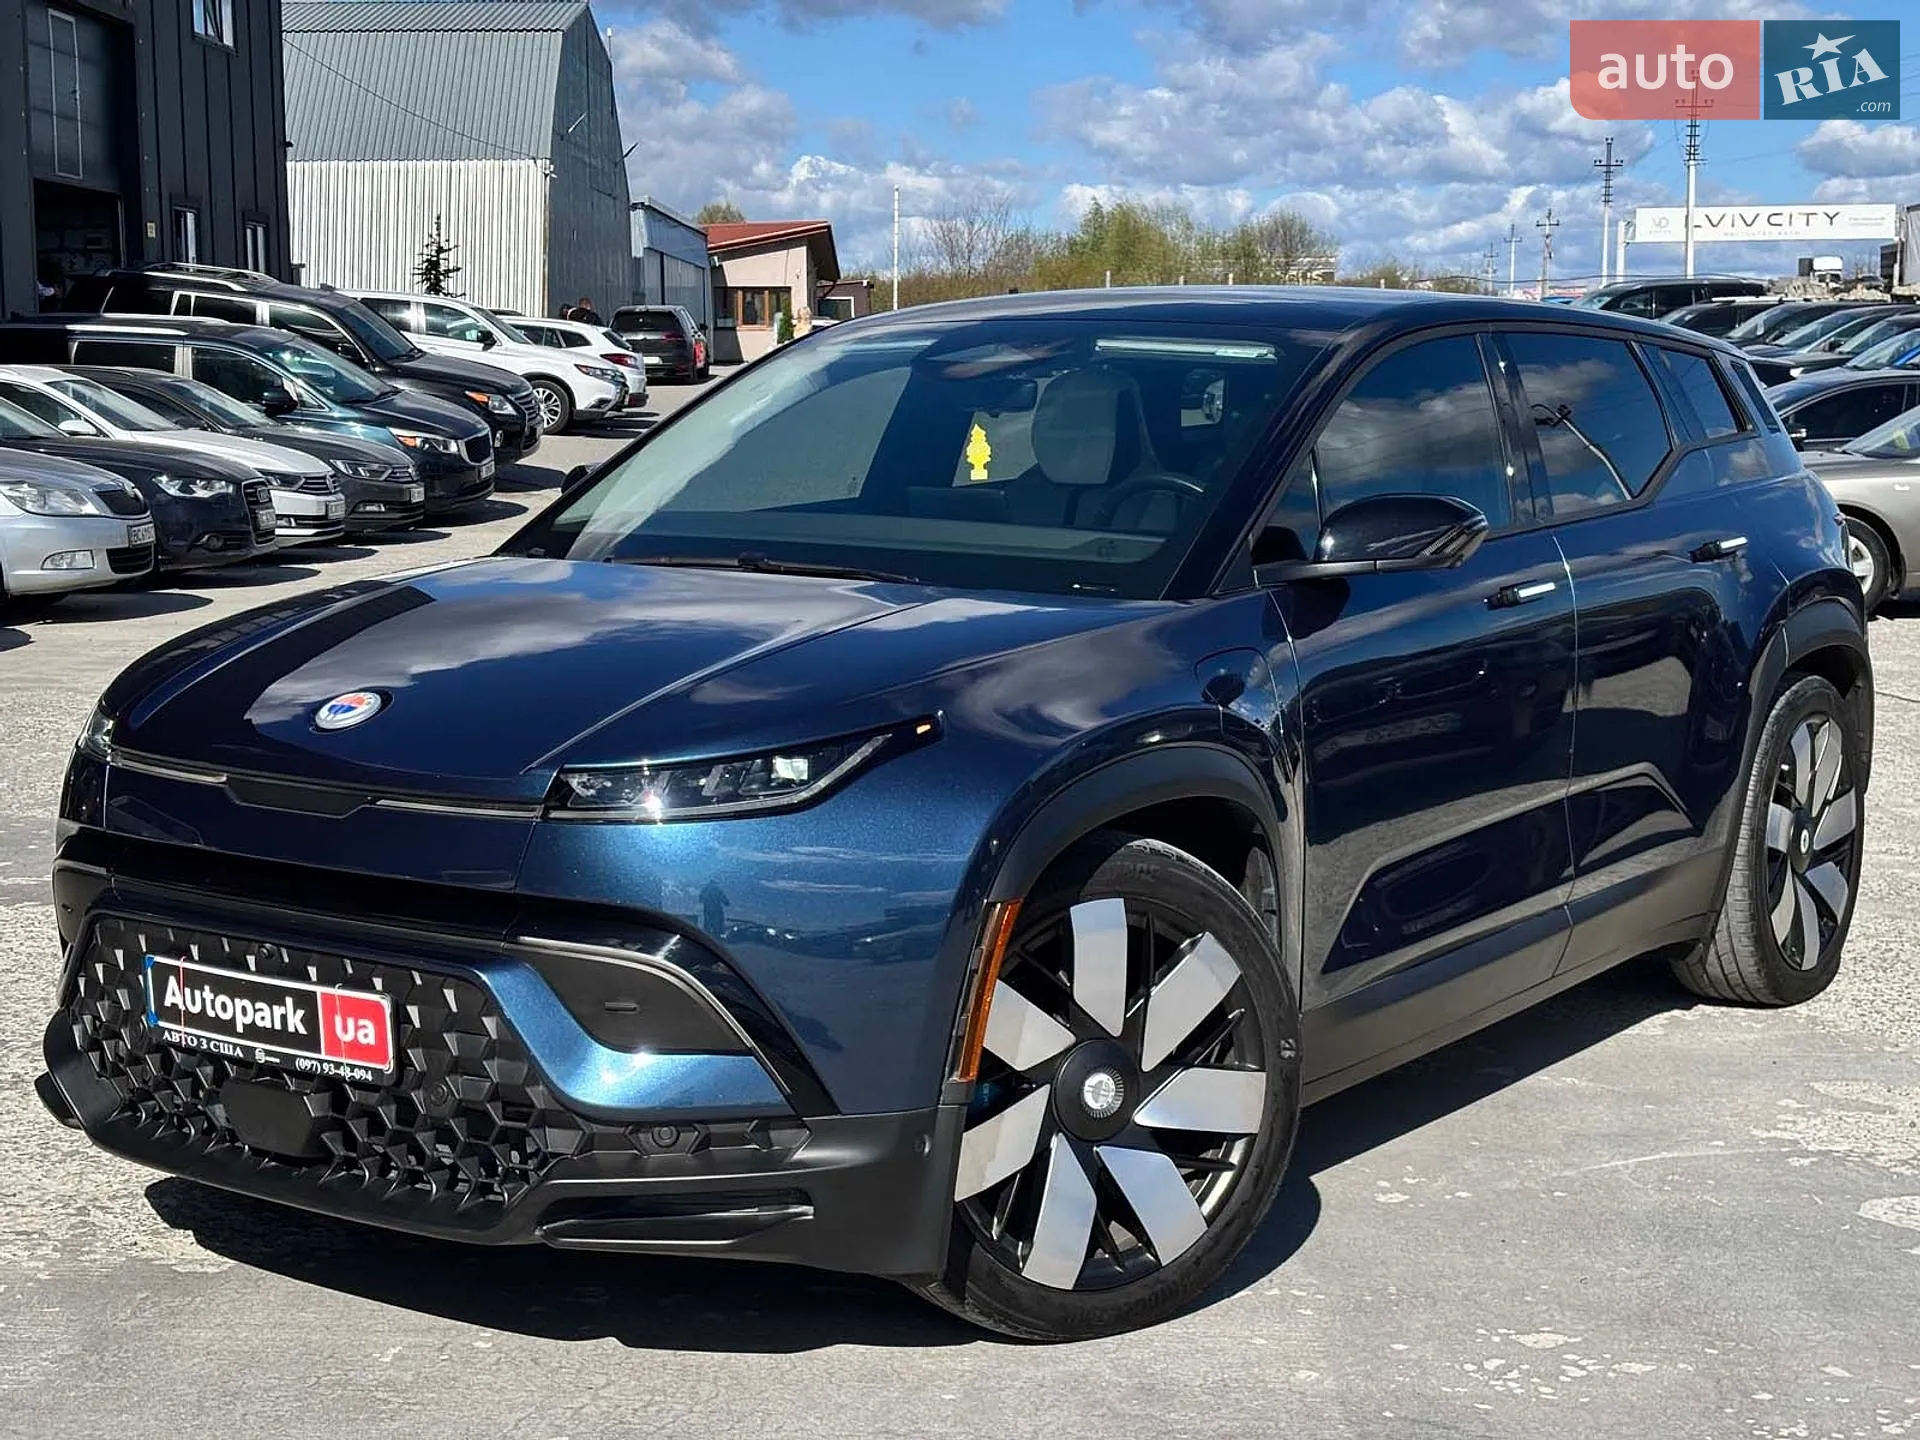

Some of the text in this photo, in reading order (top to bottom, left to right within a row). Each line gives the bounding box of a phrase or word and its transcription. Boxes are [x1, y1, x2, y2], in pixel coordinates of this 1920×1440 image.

[163, 974, 376, 1047] Autopark ua
[162, 1029, 198, 1047] АВТО
[209, 1040, 245, 1058] США
[295, 1057, 321, 1075] (097)
